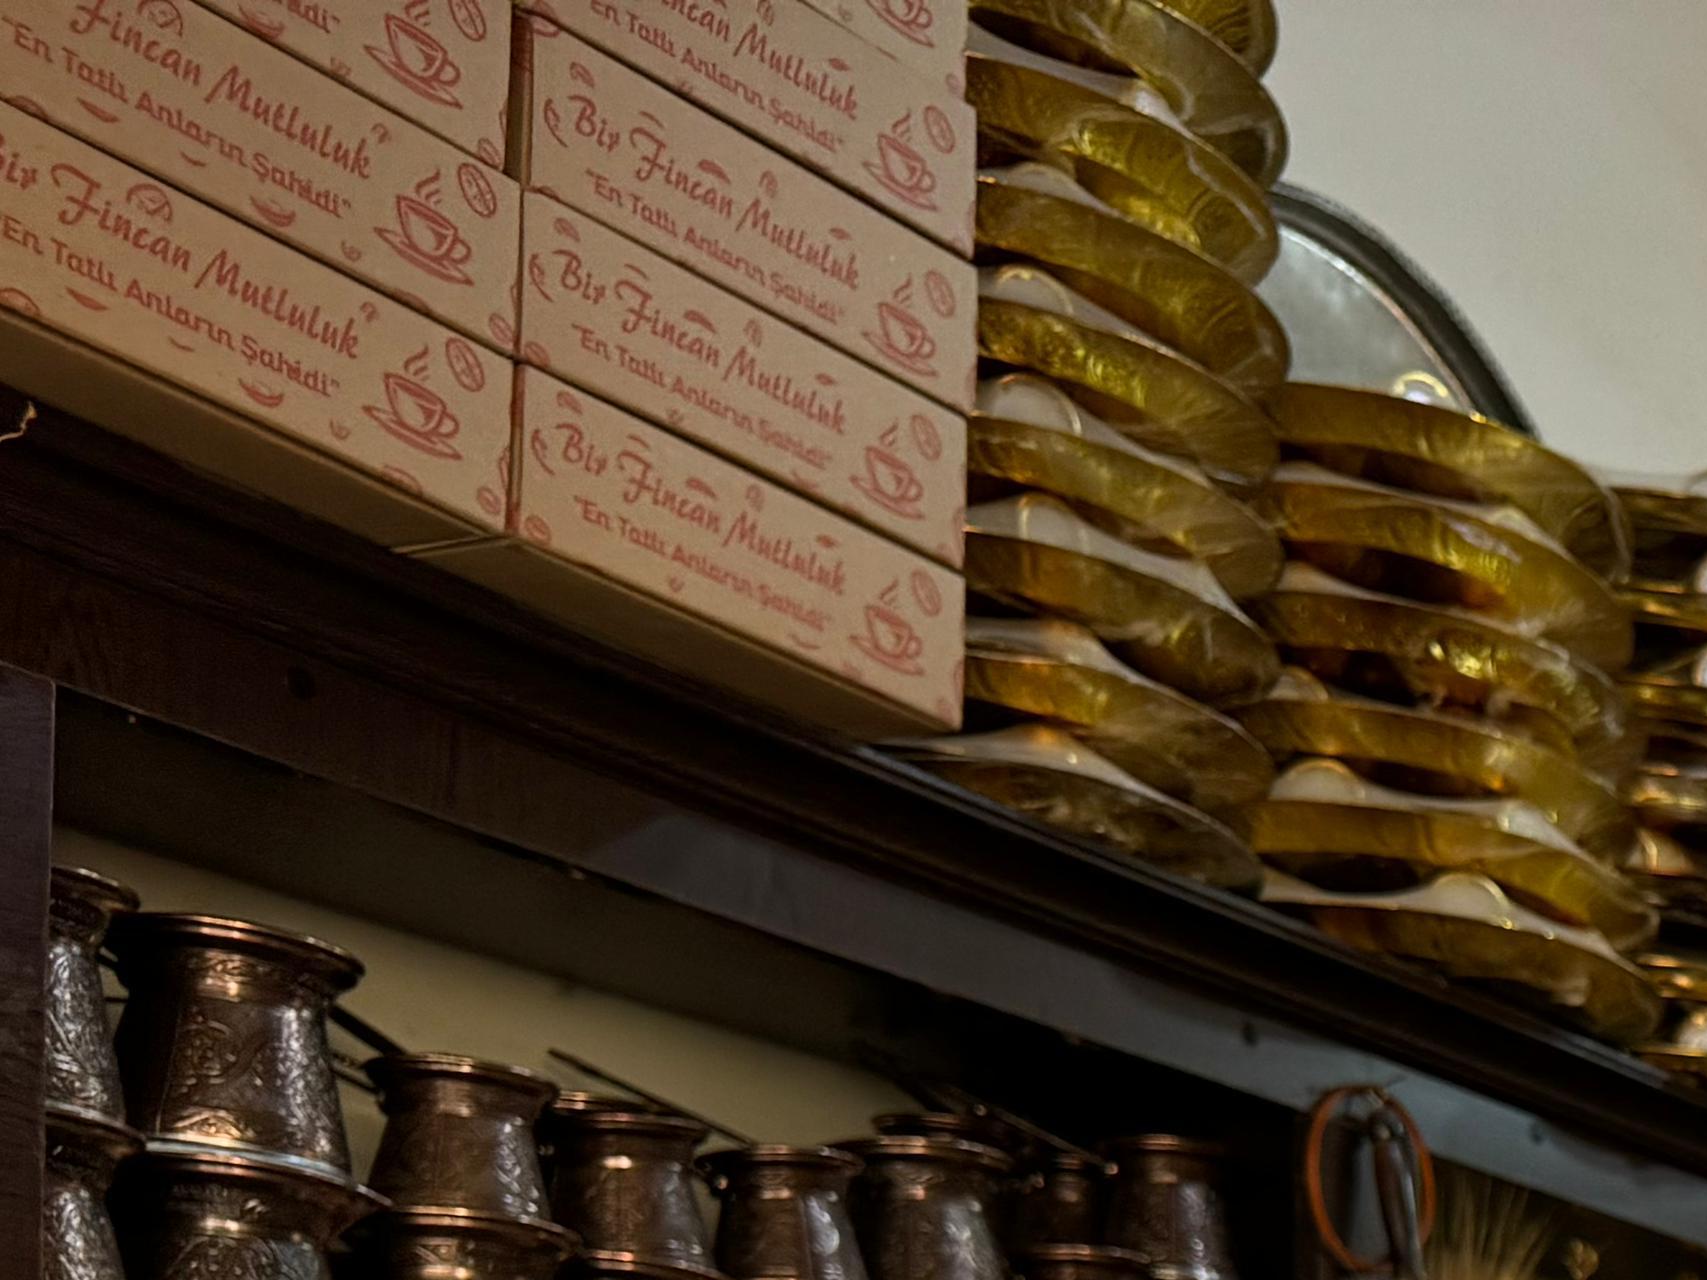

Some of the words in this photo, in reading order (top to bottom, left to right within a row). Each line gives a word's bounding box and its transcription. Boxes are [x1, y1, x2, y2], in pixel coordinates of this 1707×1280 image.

[61, 46, 129, 103] Tatlı
[134, 90, 248, 168] Anların
[204, 64, 370, 179] Mutluluk
[733, 22, 857, 120] Mutluluk
[0, 132, 38, 190] ir
[51, 163, 191, 272] Fincan
[194, 249, 359, 359] Mutluluk
[568, 94, 621, 152] Bir
[629, 127, 732, 219] Fincan
[735, 198, 859, 291] Mutluluk
[50, 237, 118, 292] Tatlı
[124, 277, 236, 351] Anların
[552, 249, 606, 304] Bir
[614, 279, 719, 367] Fincan
[722, 345, 845, 435] Mutluluk
[555, 423, 607, 476] Bir
[618, 450, 720, 533] Fincan
[722, 510, 845, 596] Mutluluk
